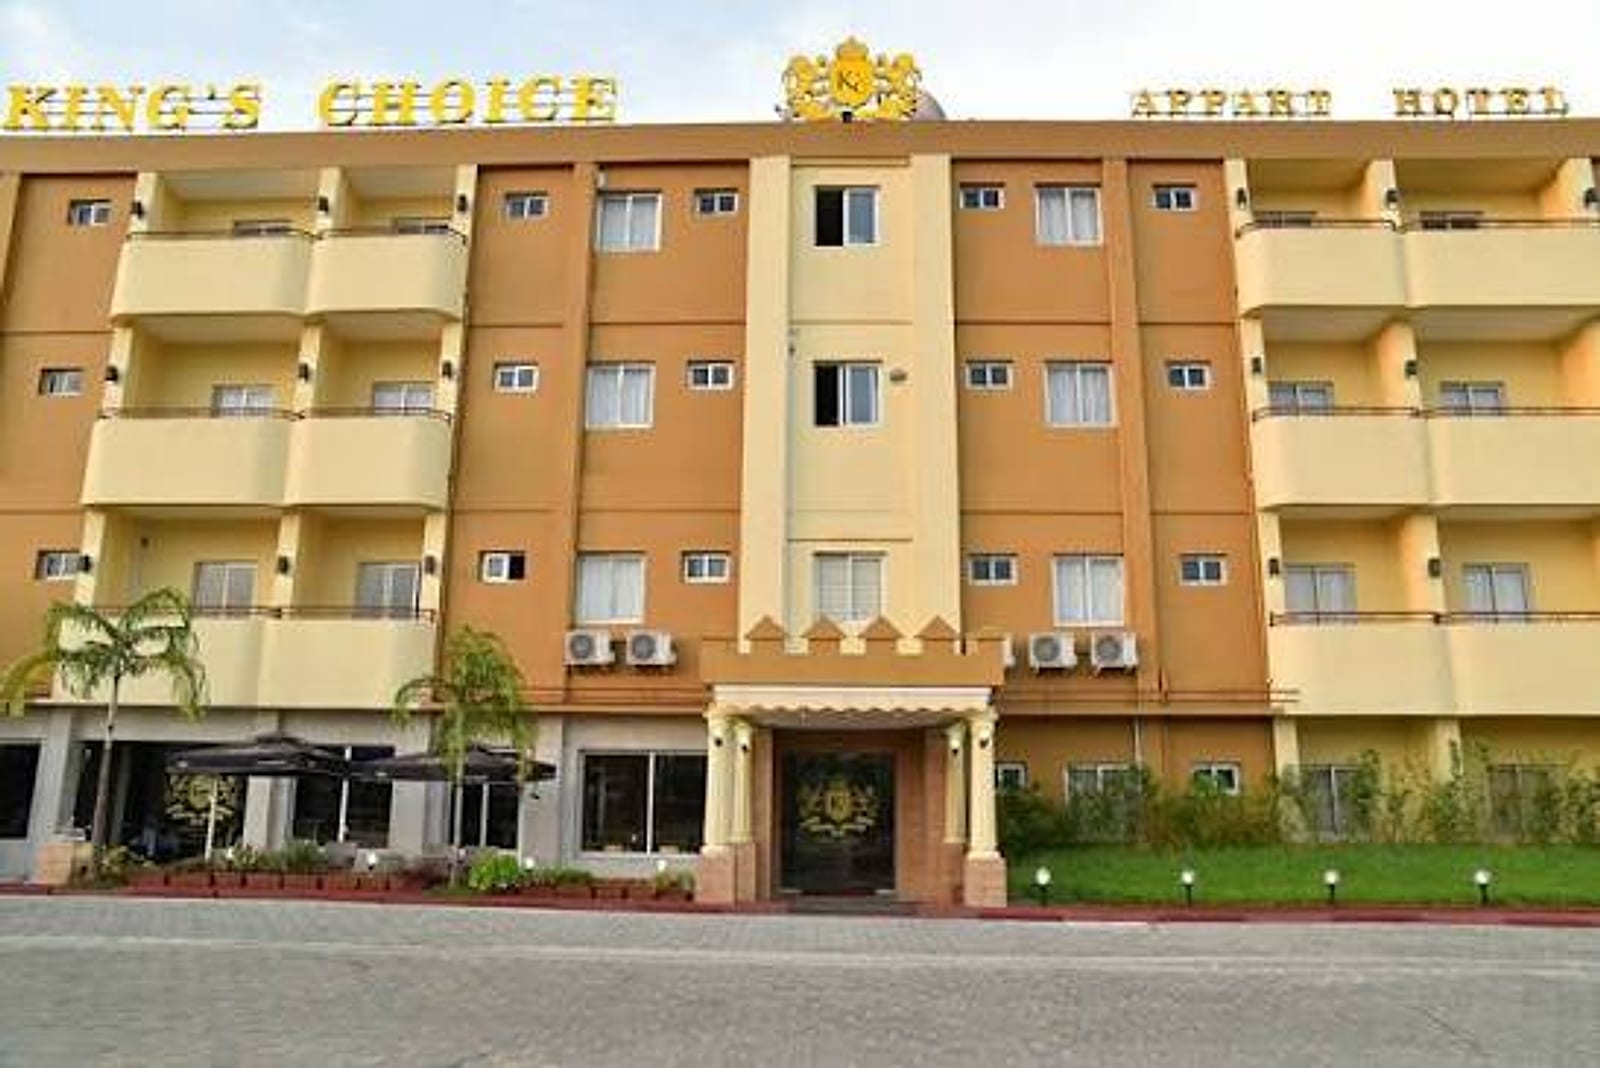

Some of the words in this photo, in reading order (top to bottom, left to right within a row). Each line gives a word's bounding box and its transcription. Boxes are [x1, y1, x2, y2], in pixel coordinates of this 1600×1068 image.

[4, 82, 261, 131] KING'S
[319, 79, 616, 126] CHOICE
[1131, 88, 1332, 118] APPART
[1392, 87, 1569, 118] HOTEL
